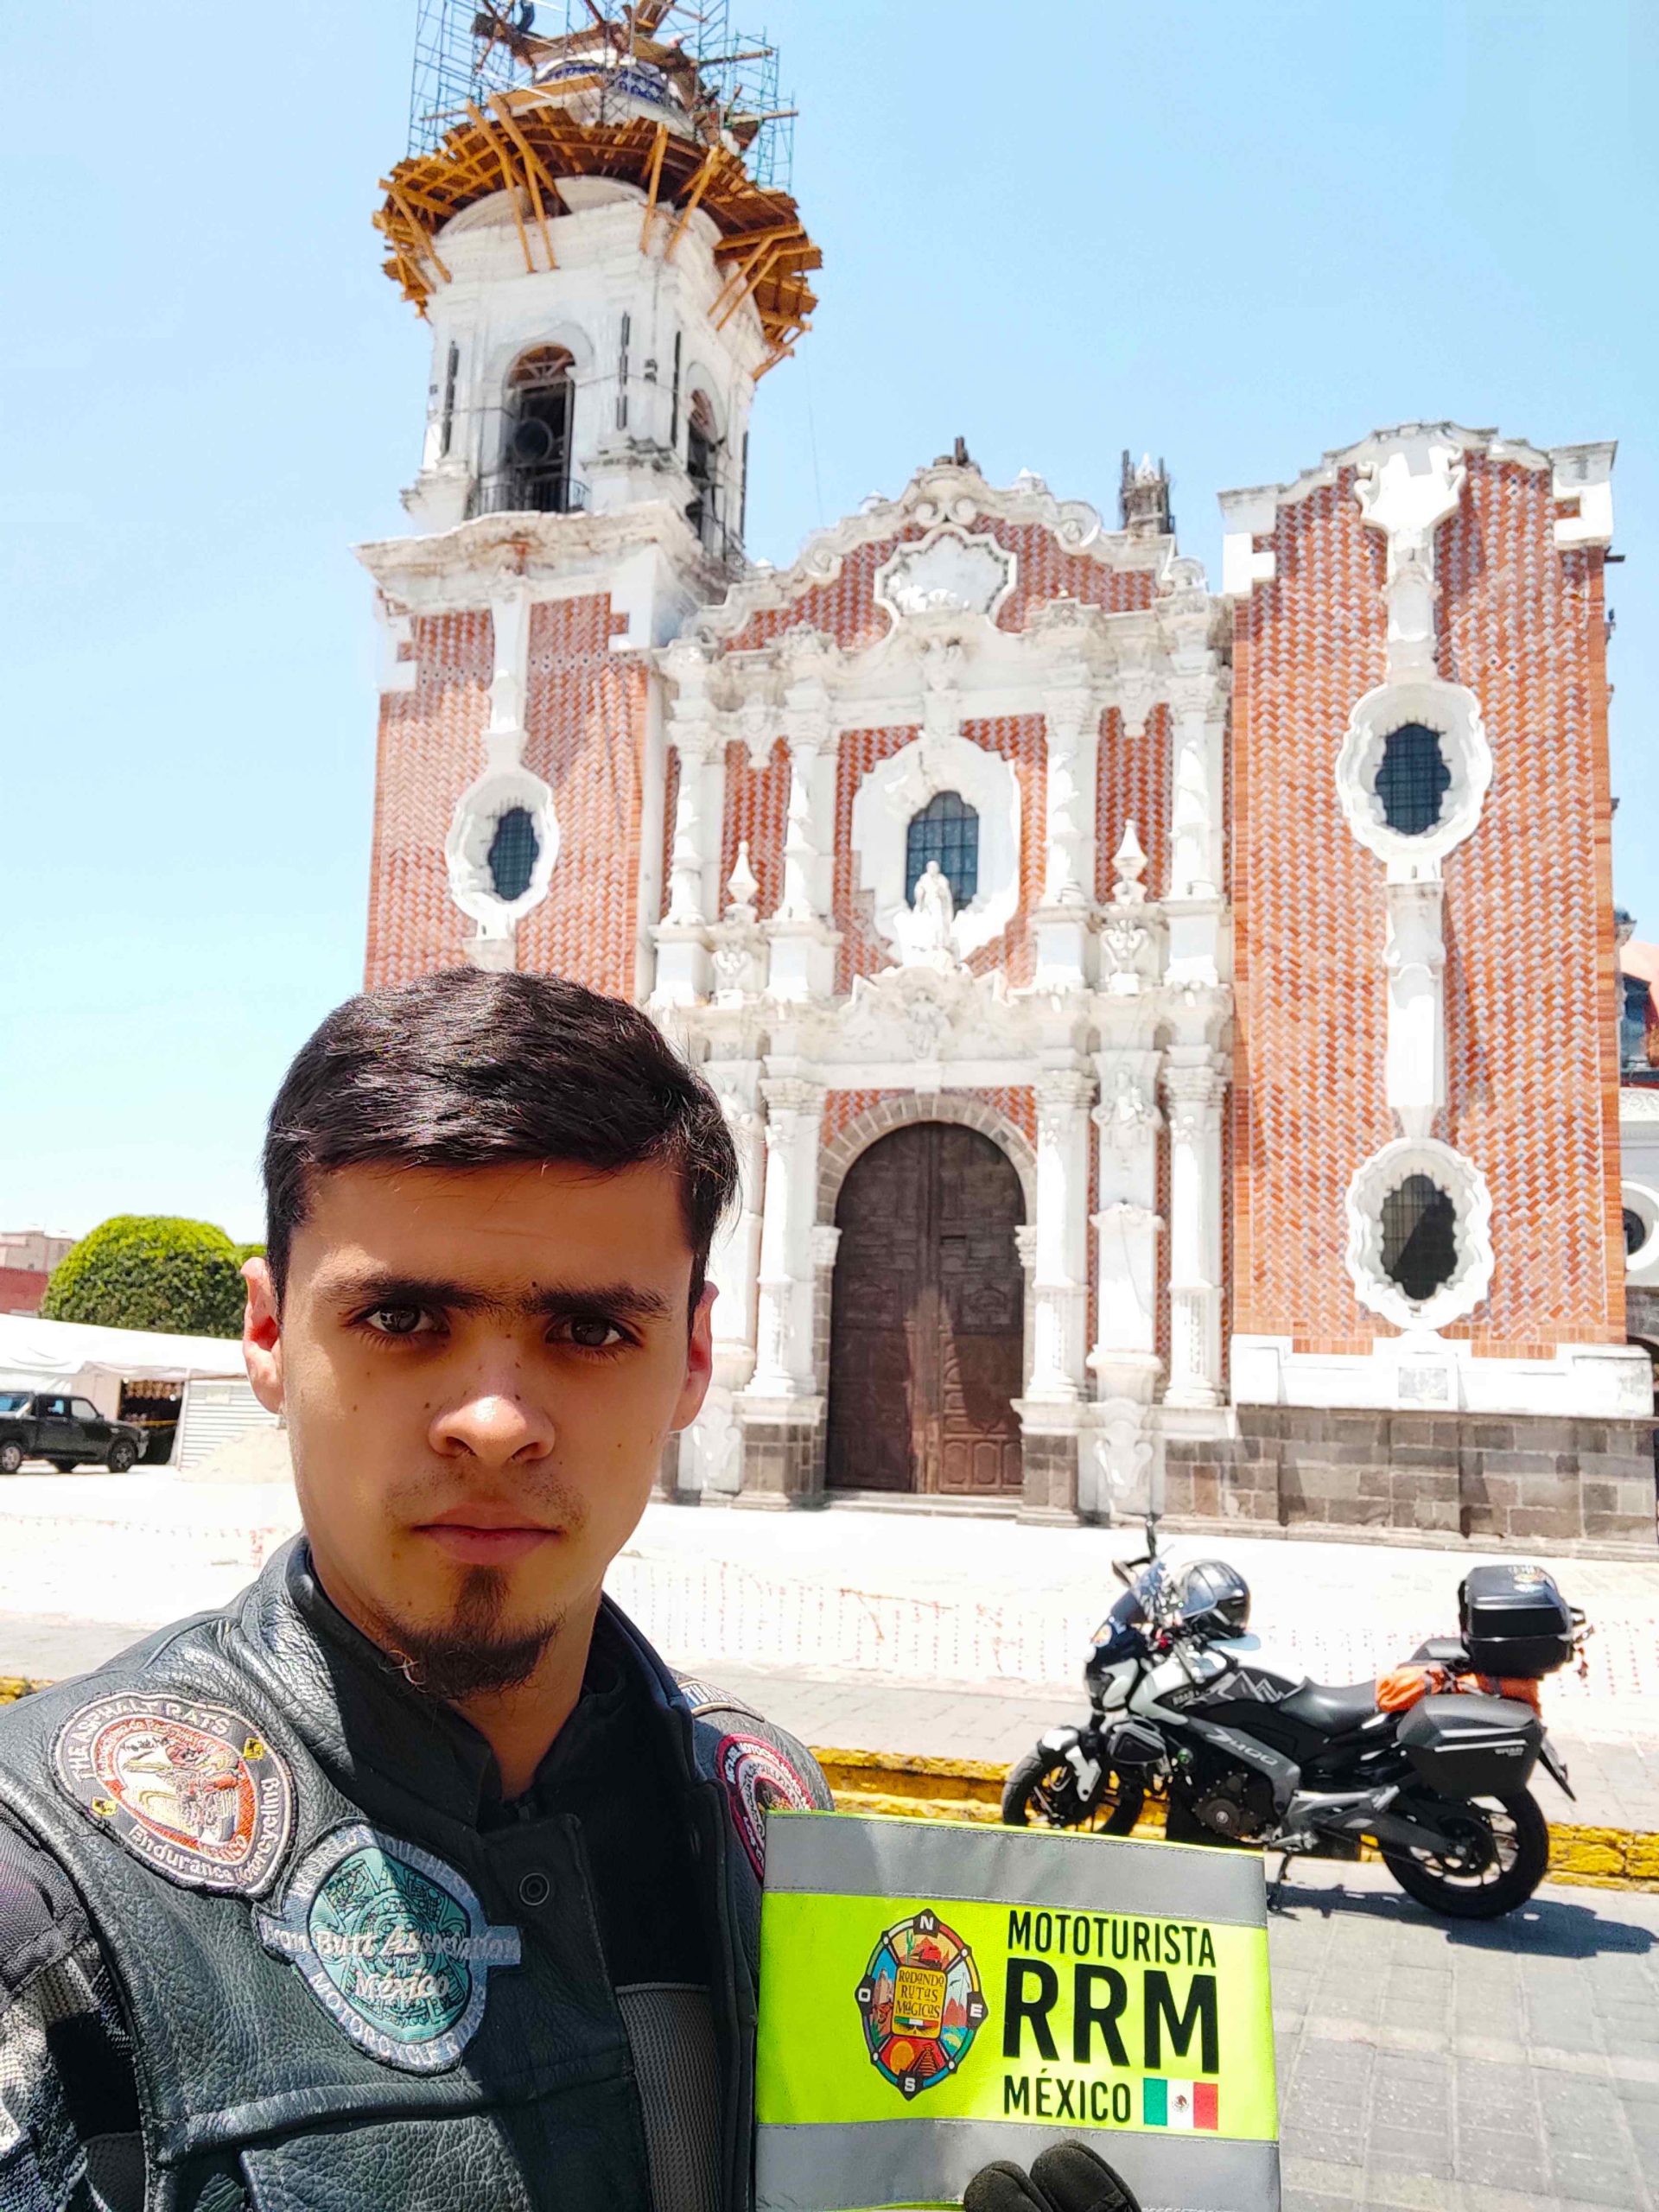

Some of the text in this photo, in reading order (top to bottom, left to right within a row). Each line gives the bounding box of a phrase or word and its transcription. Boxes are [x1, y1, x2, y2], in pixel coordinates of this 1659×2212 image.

[162, 1701, 231, 1735] RATS
[128, 1824, 234, 1882] Endurance
[919, 1916, 934, 1931] N
[1007, 1910, 1217, 1967] MOTOTURISTA
[315, 1929, 376, 1958] Butt
[380, 1925, 518, 1960] Association
[970, 2004, 983, 2018] E
[1002, 1957, 1220, 2074] RRM
[904, 2077, 916, 2092] S
[1003, 2068, 1132, 2123] MÉXICO
